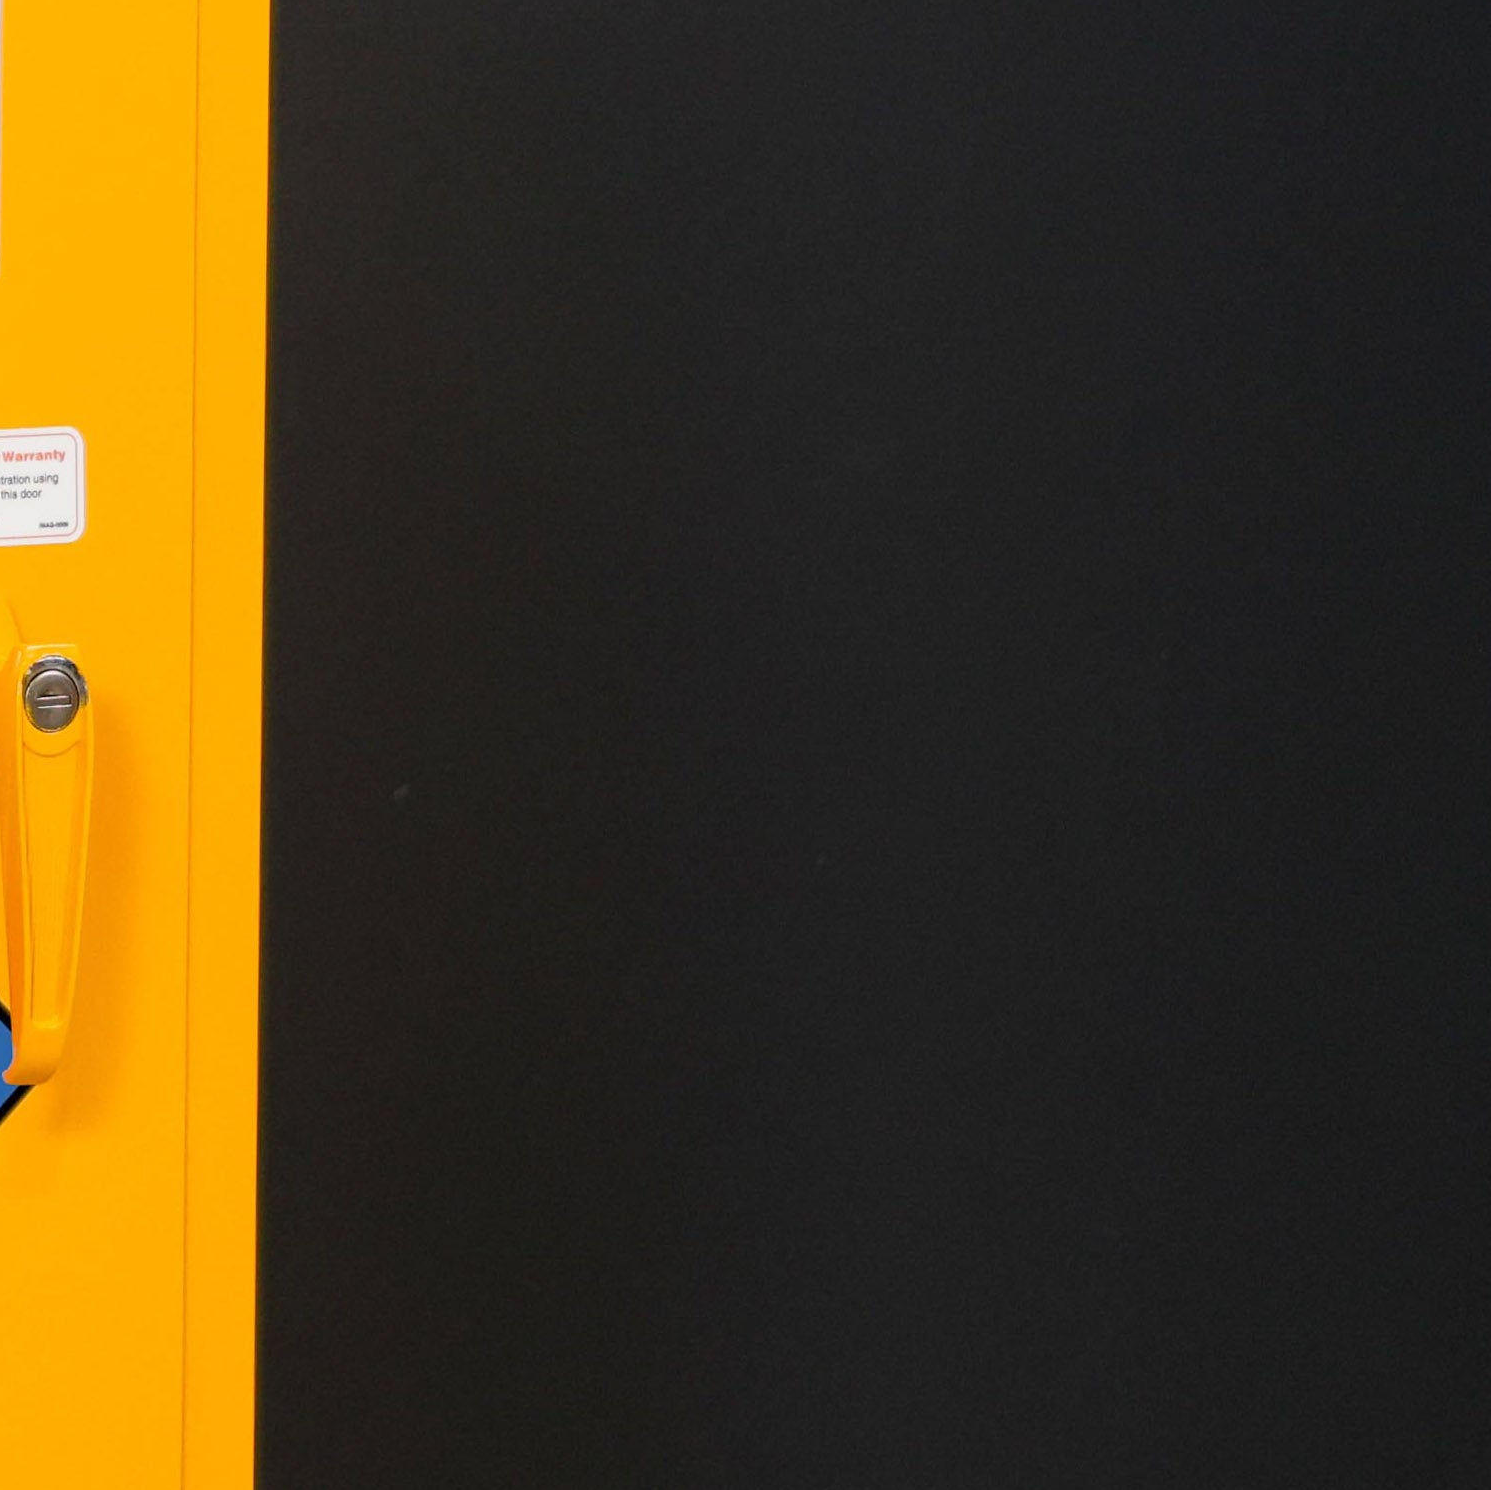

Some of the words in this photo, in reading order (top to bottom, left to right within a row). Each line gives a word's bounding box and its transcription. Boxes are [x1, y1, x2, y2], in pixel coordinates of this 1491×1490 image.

[3, 450, 66, 463] Warranty
[33, 474, 59, 485] using
[1, 490, 18, 499] this
[20, 488, 41, 498] door
